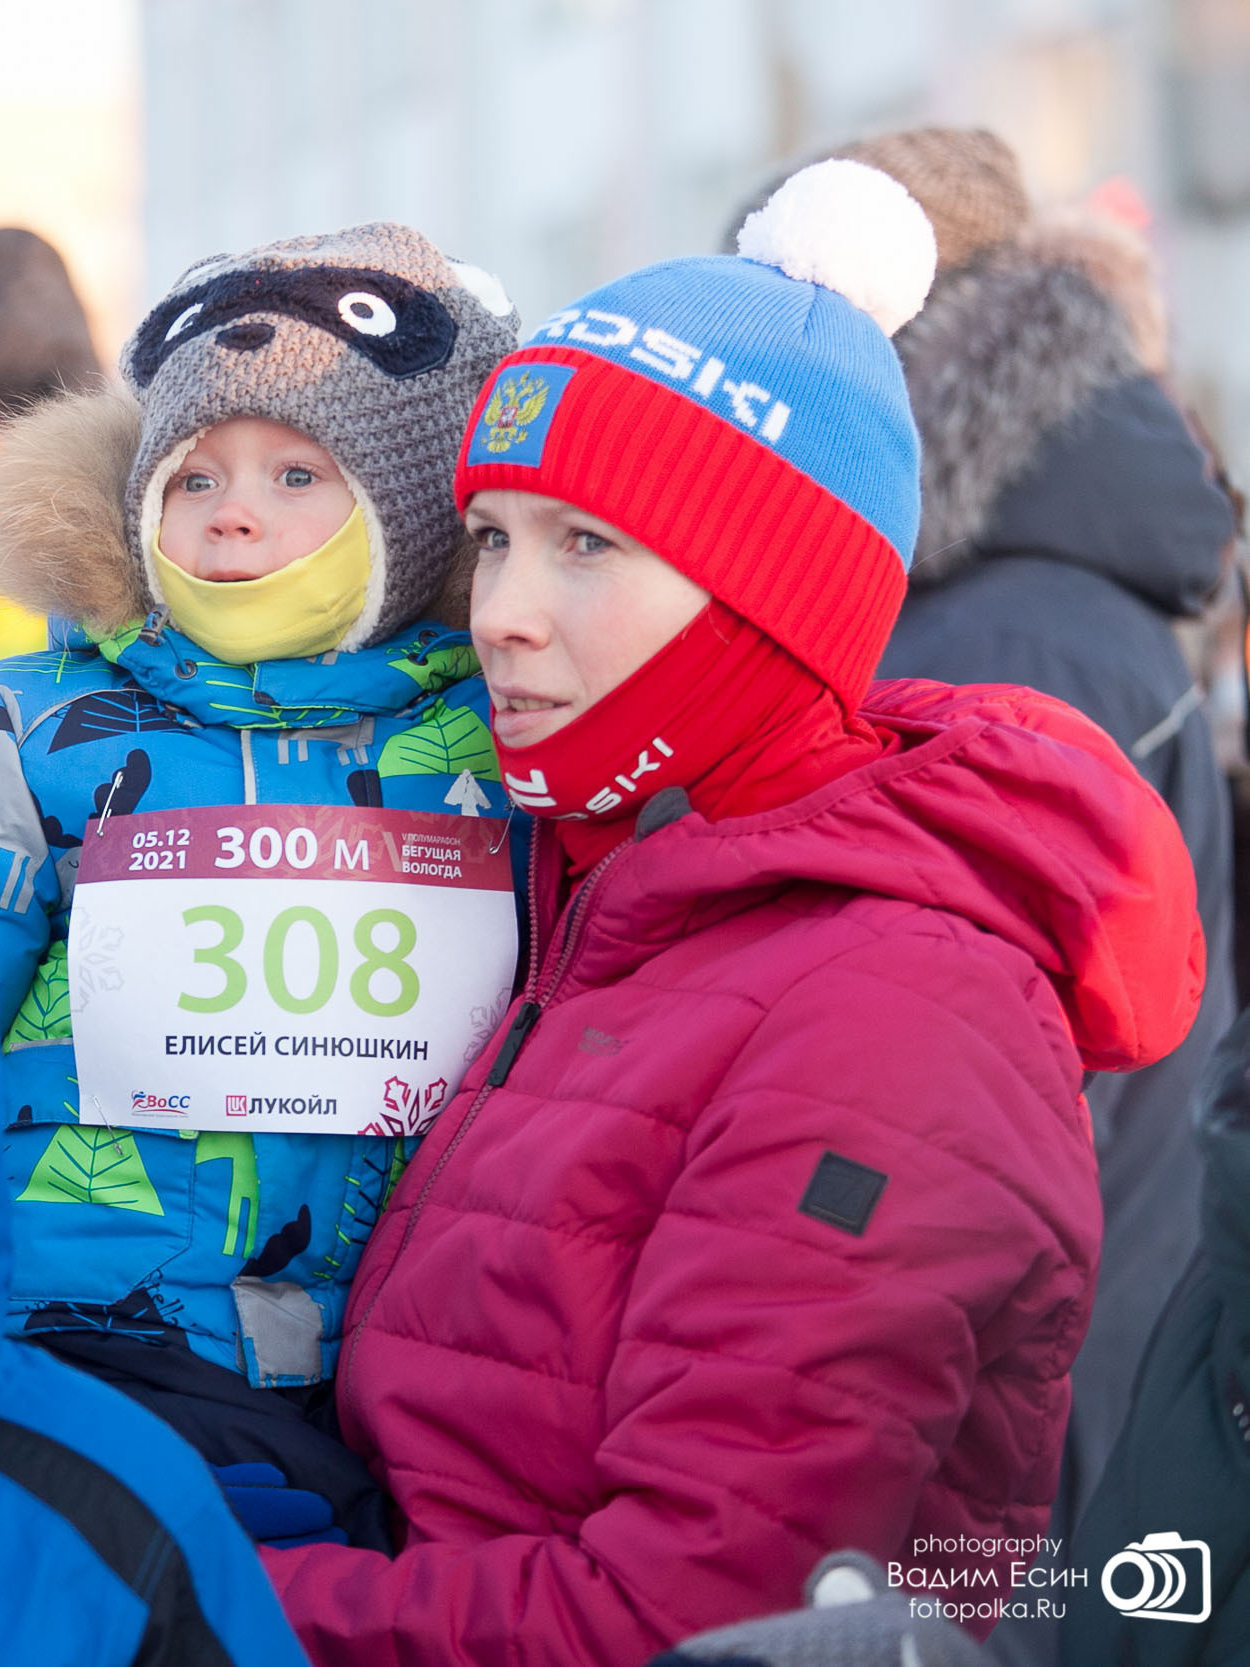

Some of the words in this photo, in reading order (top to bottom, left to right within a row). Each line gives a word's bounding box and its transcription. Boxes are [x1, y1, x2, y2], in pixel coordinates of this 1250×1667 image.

[132, 829, 191, 848] 05.12
[214, 826, 319, 870] 300
[128, 850, 188, 871] 2021
[401, 845, 461, 862] БЕГУЩАЯ
[402, 861, 462, 879] ВОЛОГДА
[178, 904, 420, 1018] 308
[164, 1031, 267, 1057] ЕЛИСЕЙ
[274, 1035, 429, 1061] СИНЮШКИН
[248, 1094, 337, 1115] ЛУКОЙЛ
